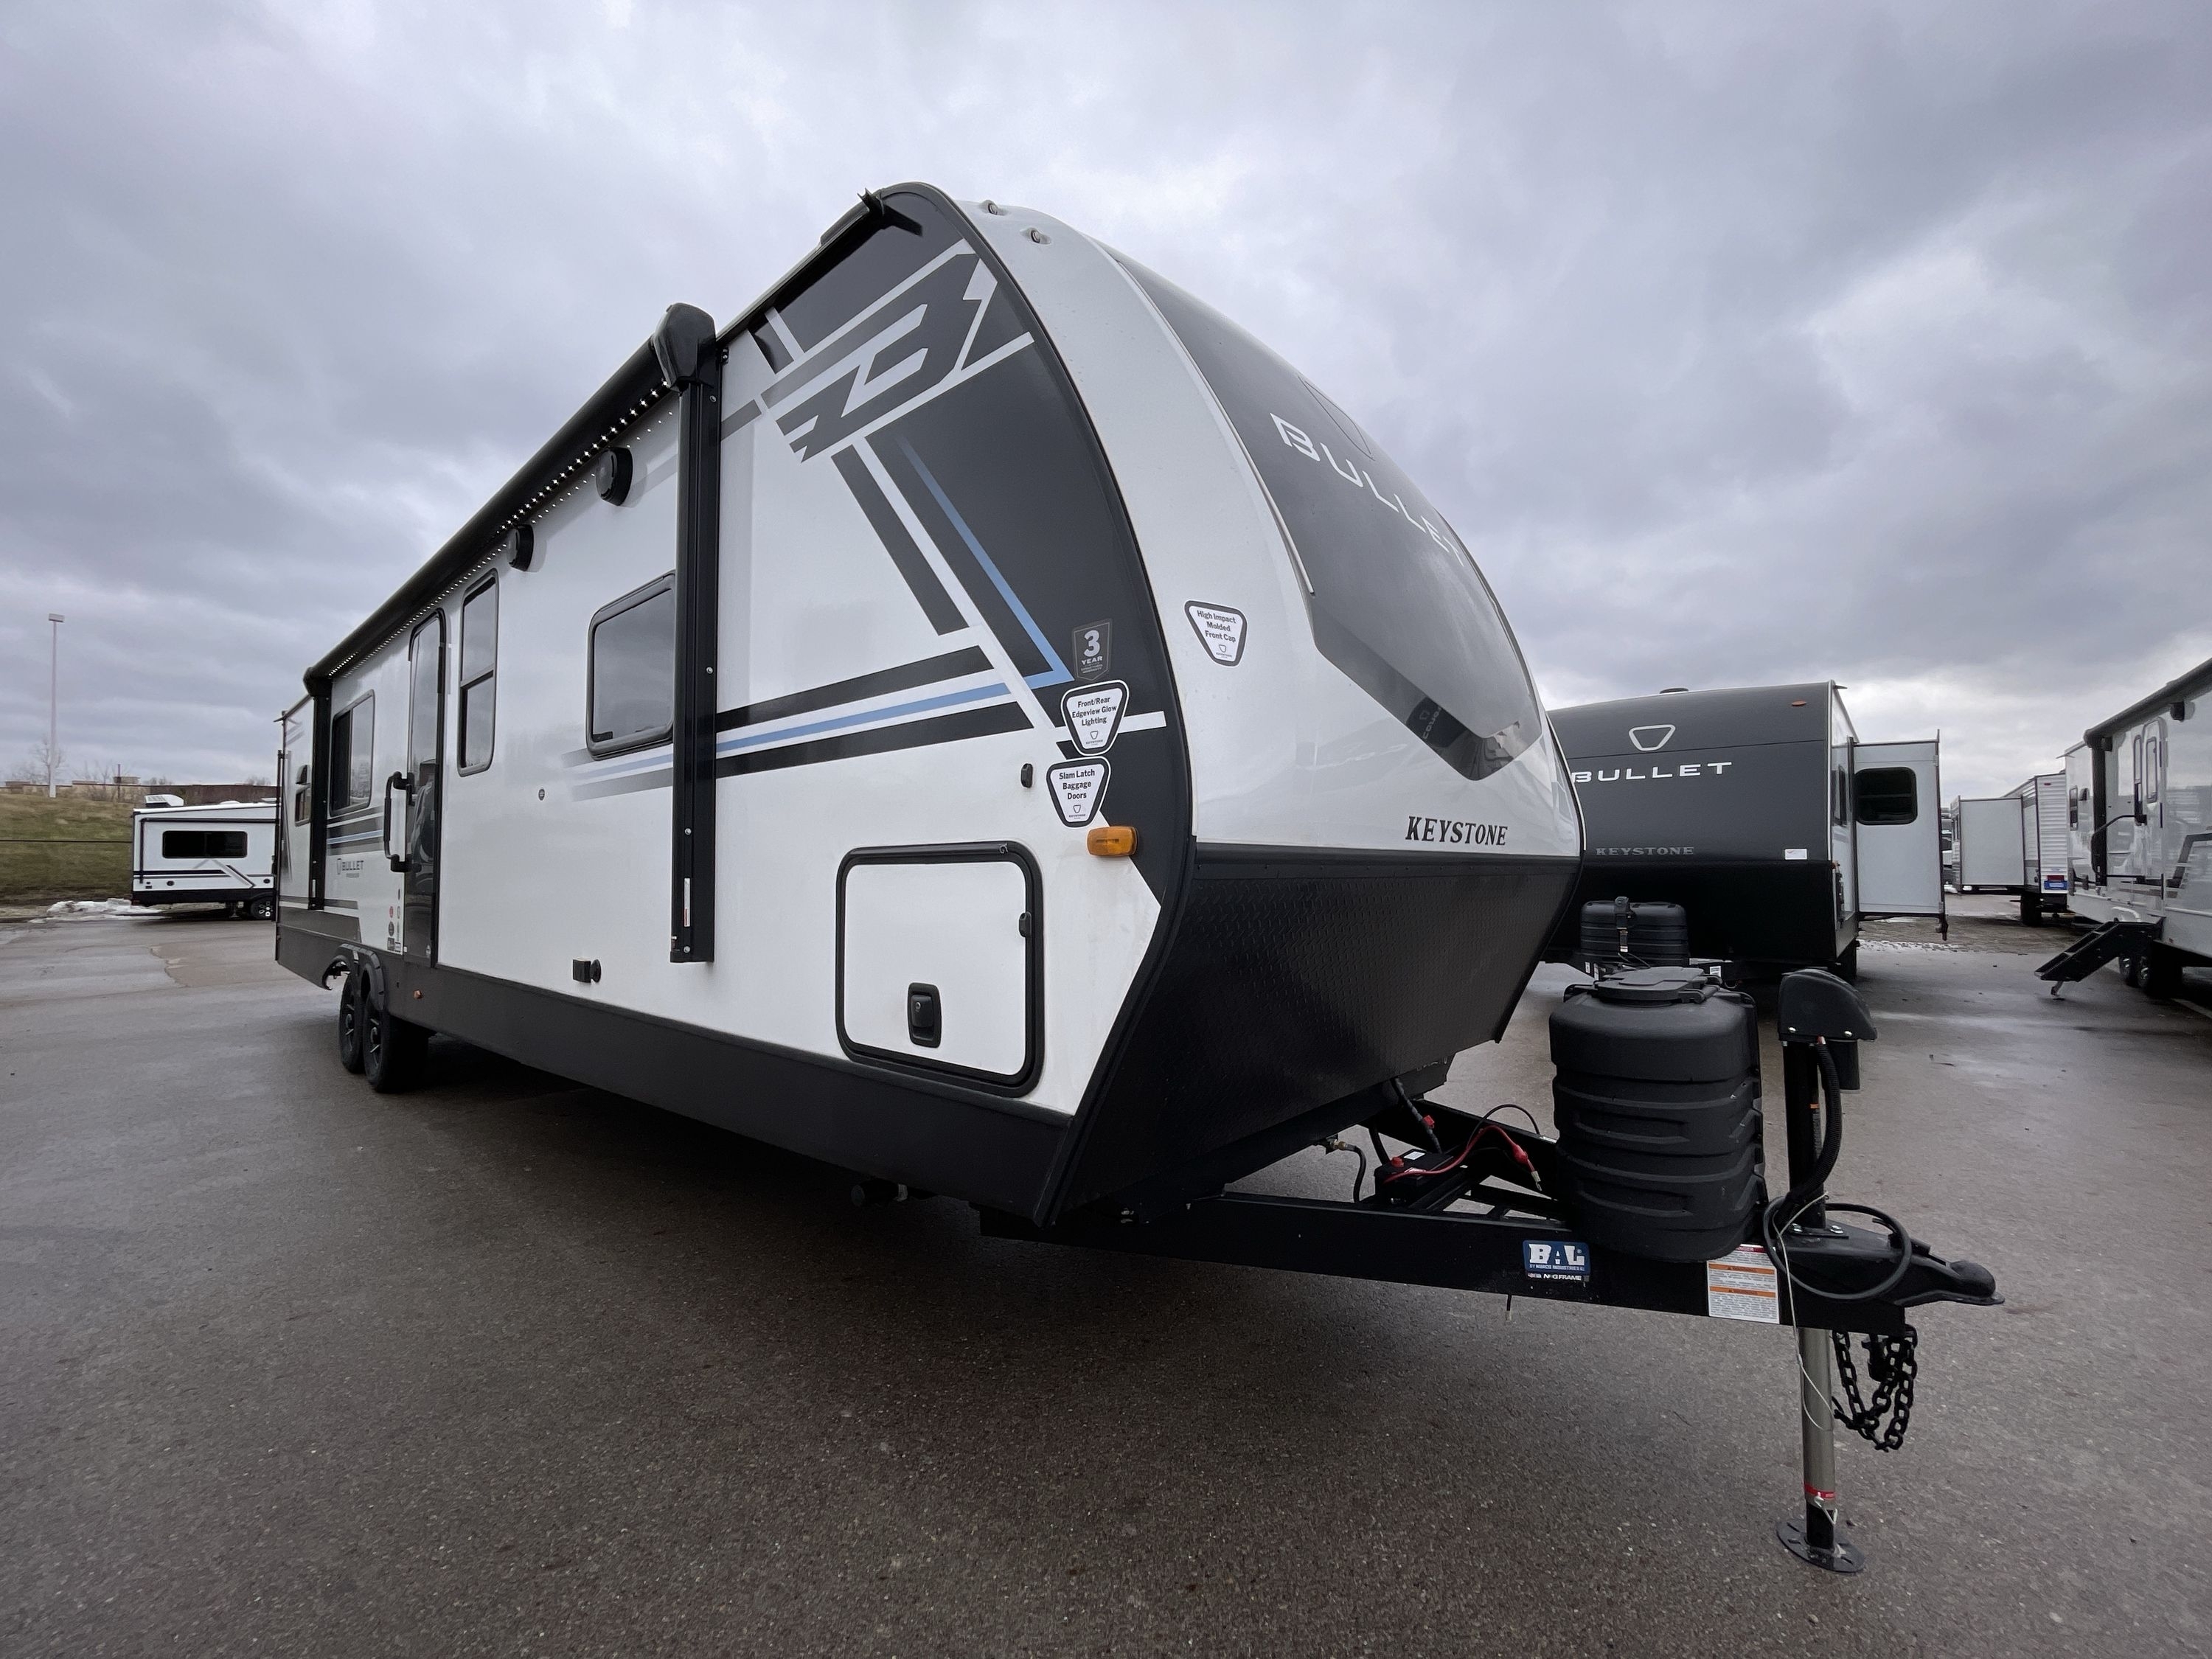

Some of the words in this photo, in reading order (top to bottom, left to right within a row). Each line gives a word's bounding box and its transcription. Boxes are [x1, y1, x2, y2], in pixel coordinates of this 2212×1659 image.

[1270, 413, 1464, 567] BULLET
[1197, 610, 1213, 619] High
[1213, 613, 1237, 624] Impact
[1206, 621, 1231, 632] Molded
[1205, 630, 1223, 640] Front
[1223, 633, 1236, 643] Cap
[1084, 630, 1100, 657] 3
[1081, 655, 1103, 665] YEAR
[1077, 697, 1111, 708] Front/Rear
[1072, 708, 1101, 719] Edgeview
[1081, 717, 1107, 726] Lighting
[1059, 772, 1076, 780] Slam
[1076, 768, 1095, 778] Latch
[1571, 762, 1732, 783] BULLET
[1062, 781, 1092, 790] Baggage
[1405, 815, 1509, 846] KEYSTONE
[1596, 846, 1694, 856] KEYSTONE
[1528, 1243, 1585, 1265] BAL
